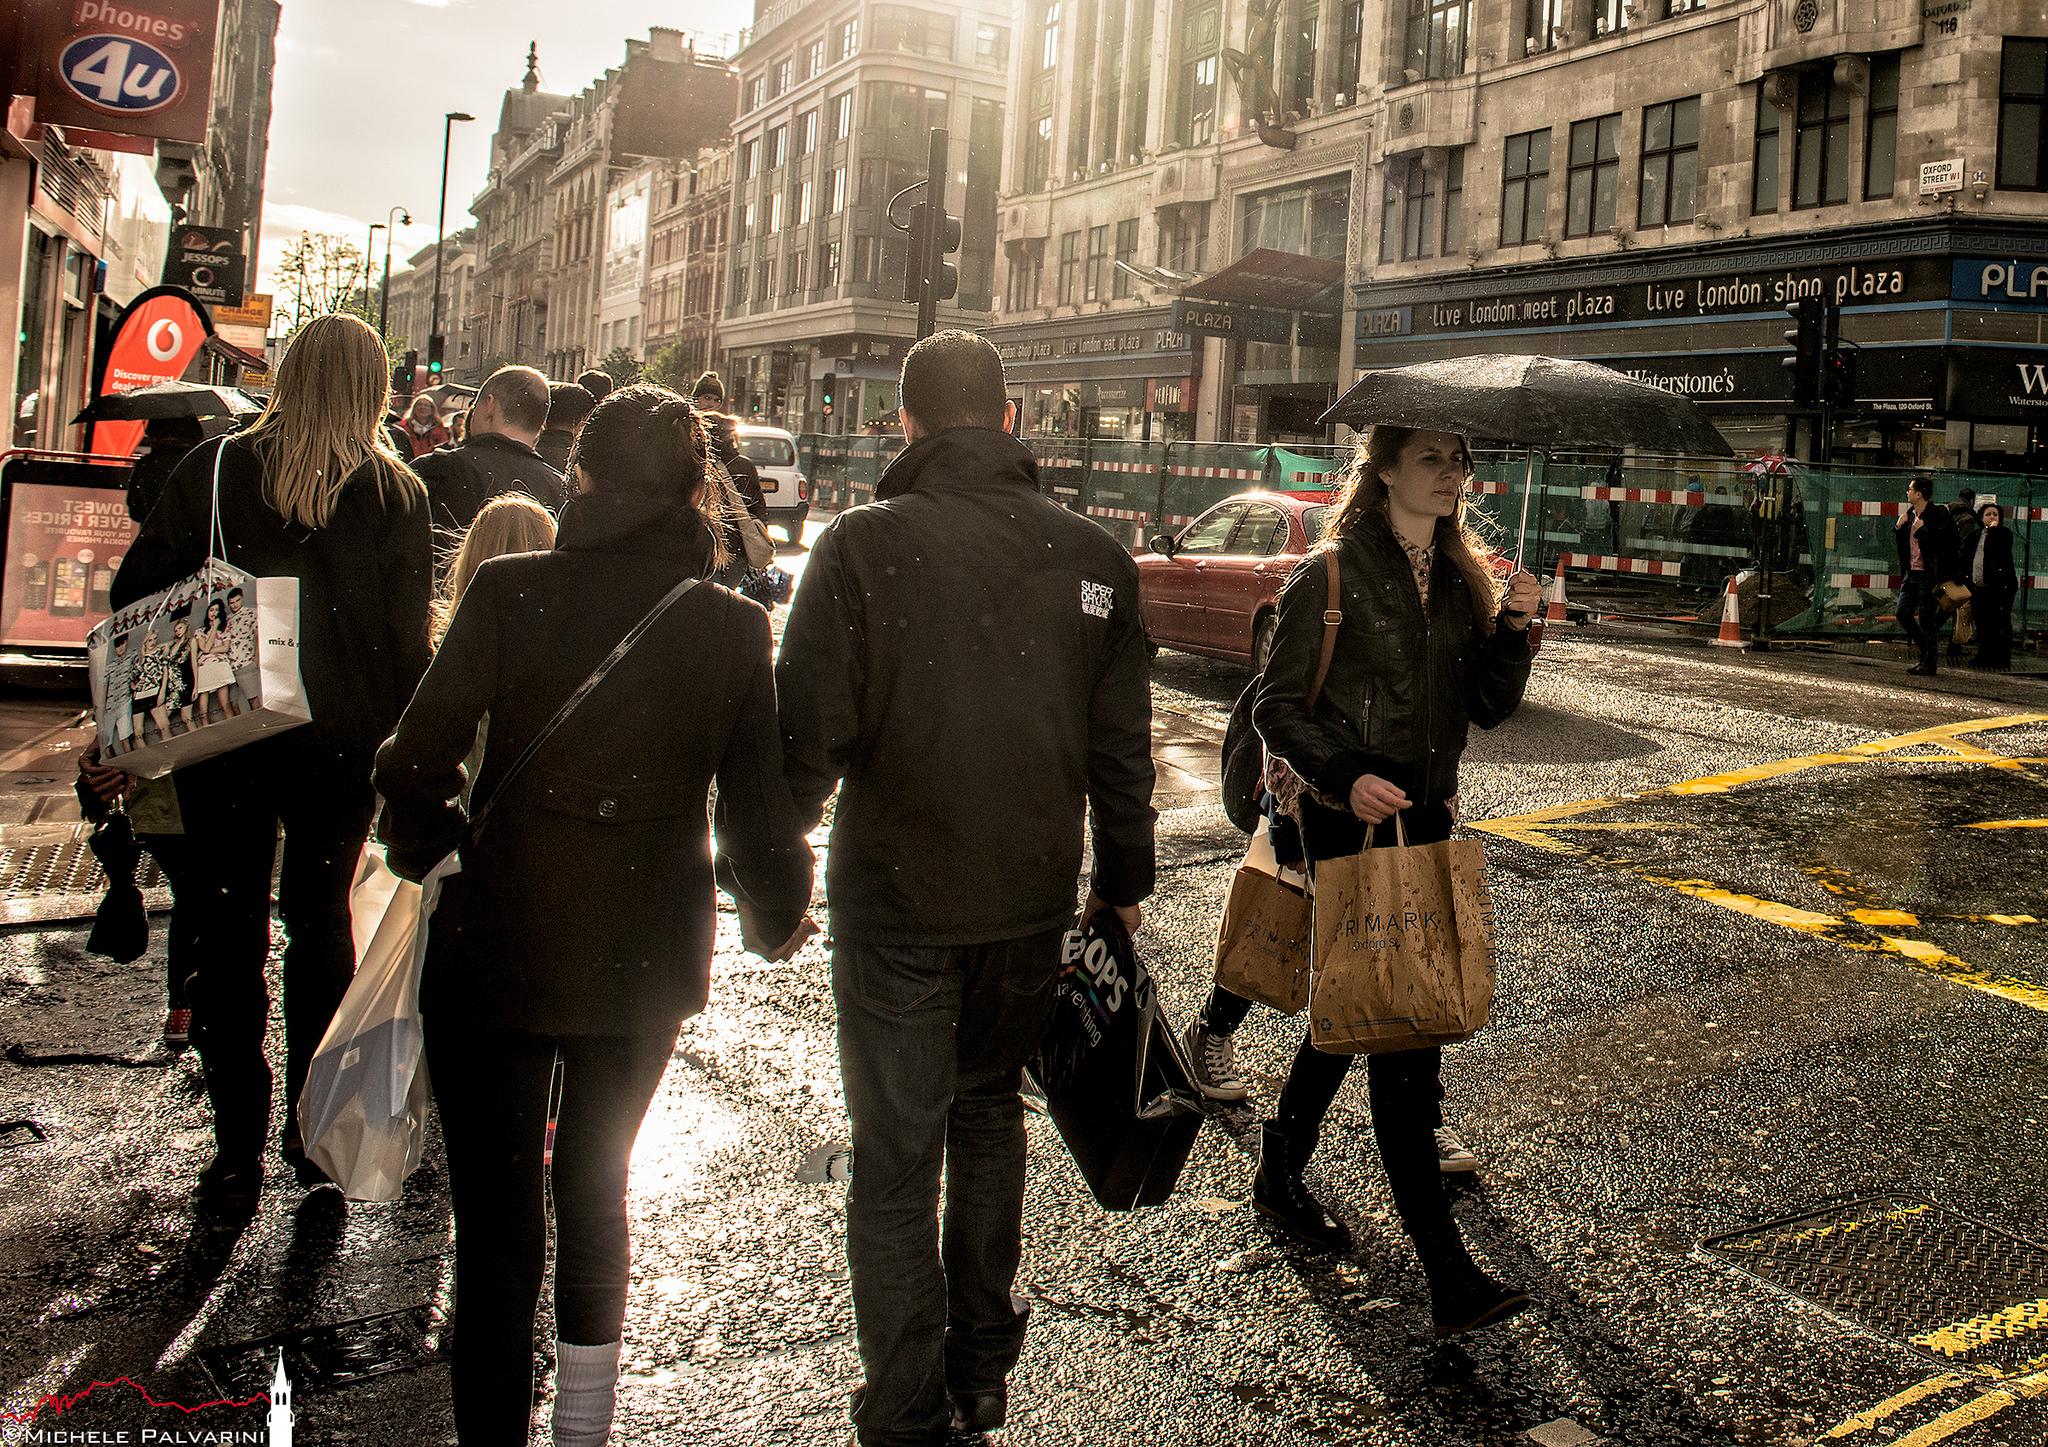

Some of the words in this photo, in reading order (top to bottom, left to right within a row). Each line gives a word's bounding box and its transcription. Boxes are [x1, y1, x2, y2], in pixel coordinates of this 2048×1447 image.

[80, 0, 184, 40] phones
[1937, 17, 1957, 35] 116
[70, 41, 171, 102] 4u
[1923, 164, 1952, 175] OXFORD
[1922, 174, 1948, 184] STREET
[181, 252, 229, 266] JESSOPS
[191, 286, 226, 297] MINUTE
[1647, 284, 1685, 311] live
[1836, 266, 1903, 306] plaza
[221, 306, 263, 316] CHANGE
[1433, 304, 1461, 327] live
[1523, 296, 1557, 319] meet
[1567, 291, 1614, 323] plaza
[1186, 310, 1232, 329] PLAZA
[1360, 310, 1402, 335] PLAZA
[1104, 336, 1116, 351] eat
[1118, 333, 1140, 354] plaza
[114, 368, 151, 382] Discover
[1081, 580, 1114, 598] SUPER
[268, 637, 285, 646] mix
[287, 638, 294, 647] &
[1336, 911, 1438, 937] PRIMARK
[1354, 937, 1386, 951] Oxford
